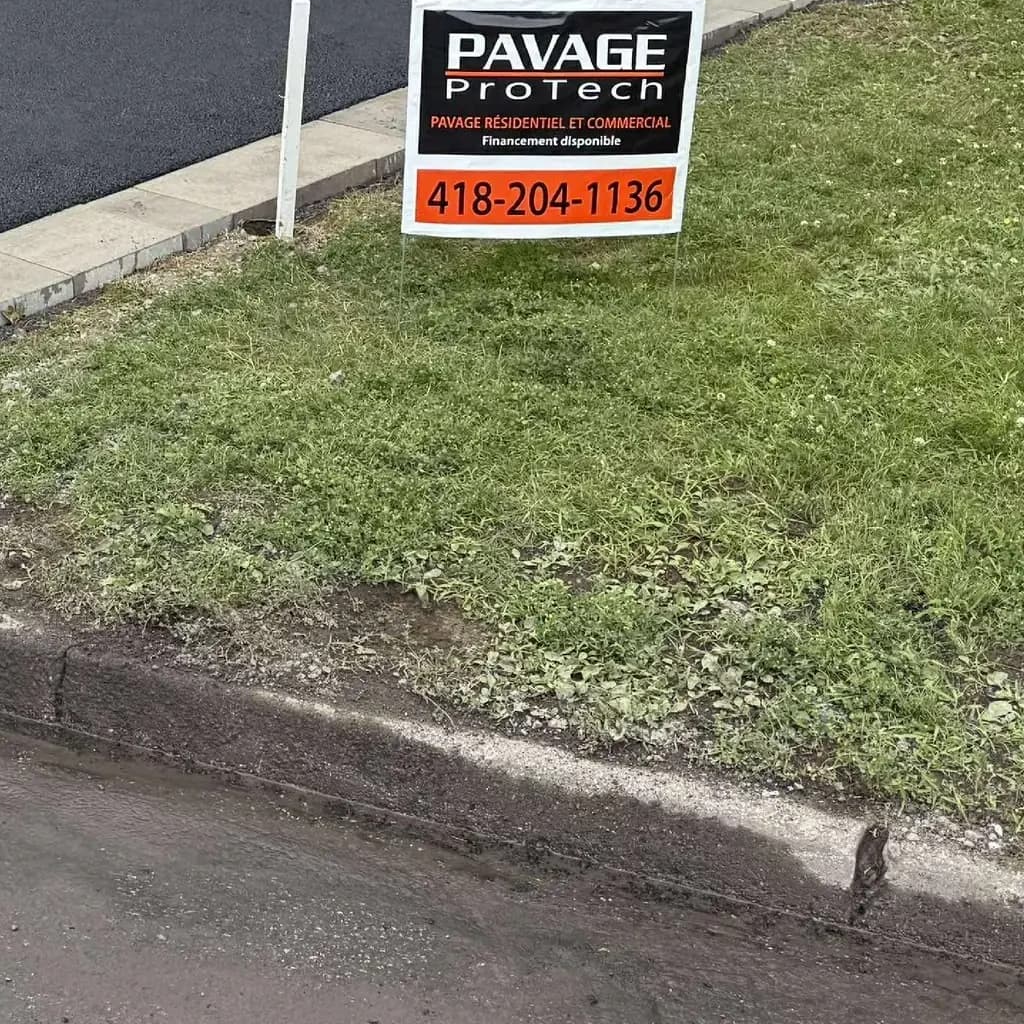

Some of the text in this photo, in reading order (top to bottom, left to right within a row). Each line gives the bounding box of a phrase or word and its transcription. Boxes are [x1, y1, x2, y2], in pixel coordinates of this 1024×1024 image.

[446, 32, 668, 71] PAVAGE
[445, 78, 663, 100] ProTech
[431, 114, 672, 129] PAVAGE RÉSIDENTIEL ET COMMERCIAL
[482, 135, 622, 148] Financement disponible
[427, 179, 664, 216] 418-204-1136
